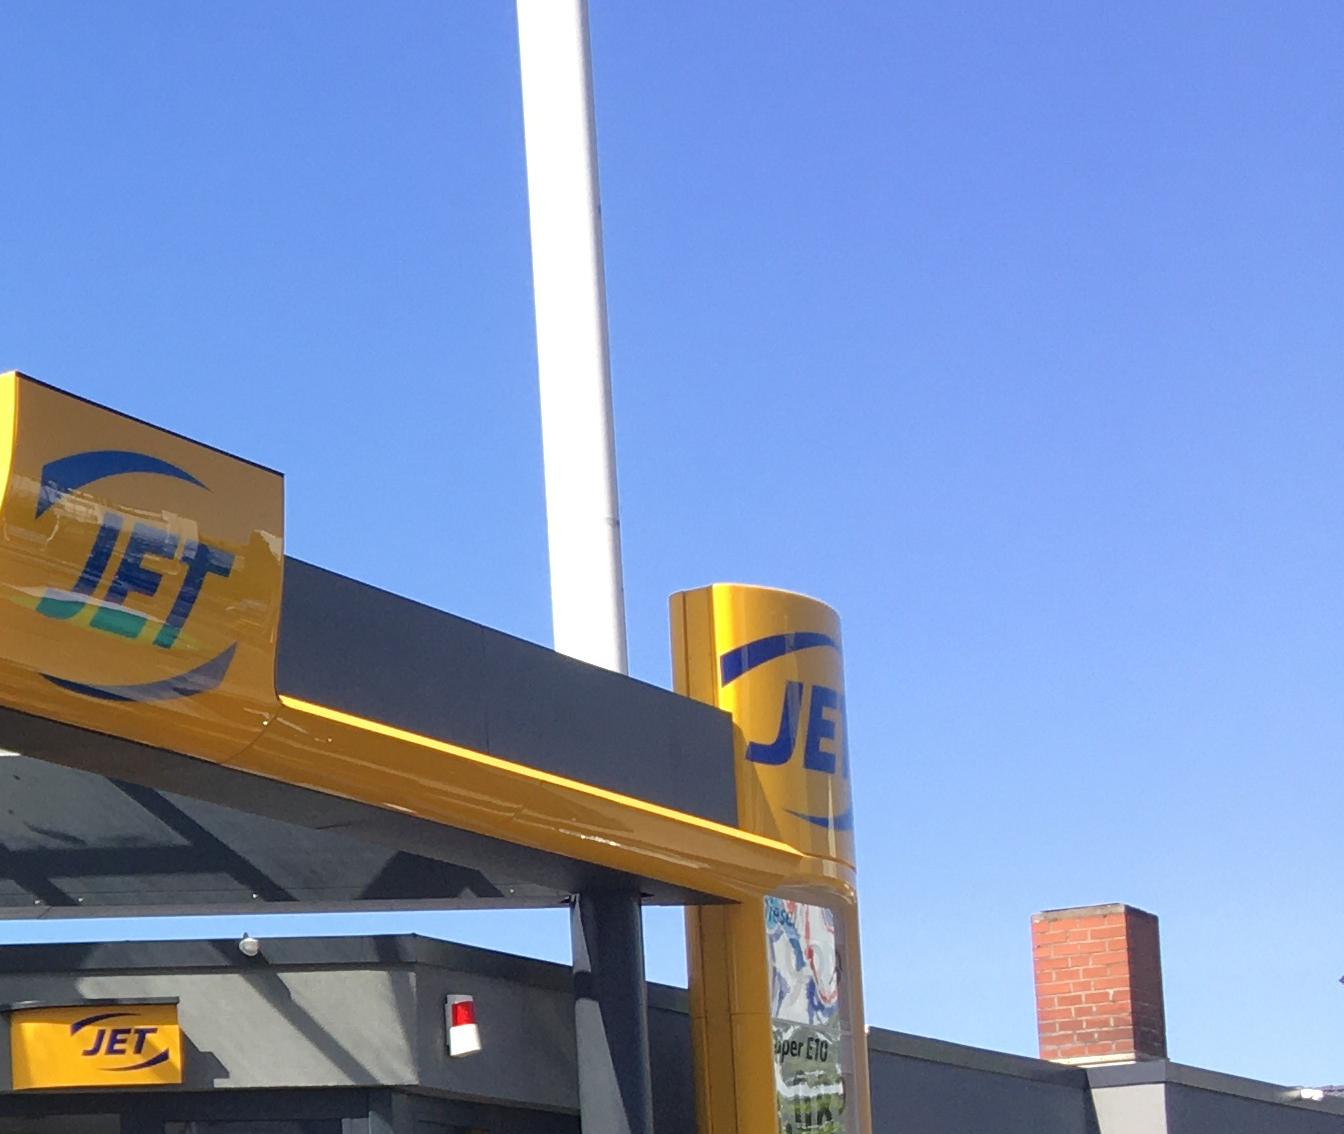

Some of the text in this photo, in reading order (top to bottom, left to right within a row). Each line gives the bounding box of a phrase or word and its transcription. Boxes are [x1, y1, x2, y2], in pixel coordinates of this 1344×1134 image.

[35, 511, 235, 649] JET
[81, 1027, 158, 1056] JET
[774, 1037, 829, 1062] uper E10
